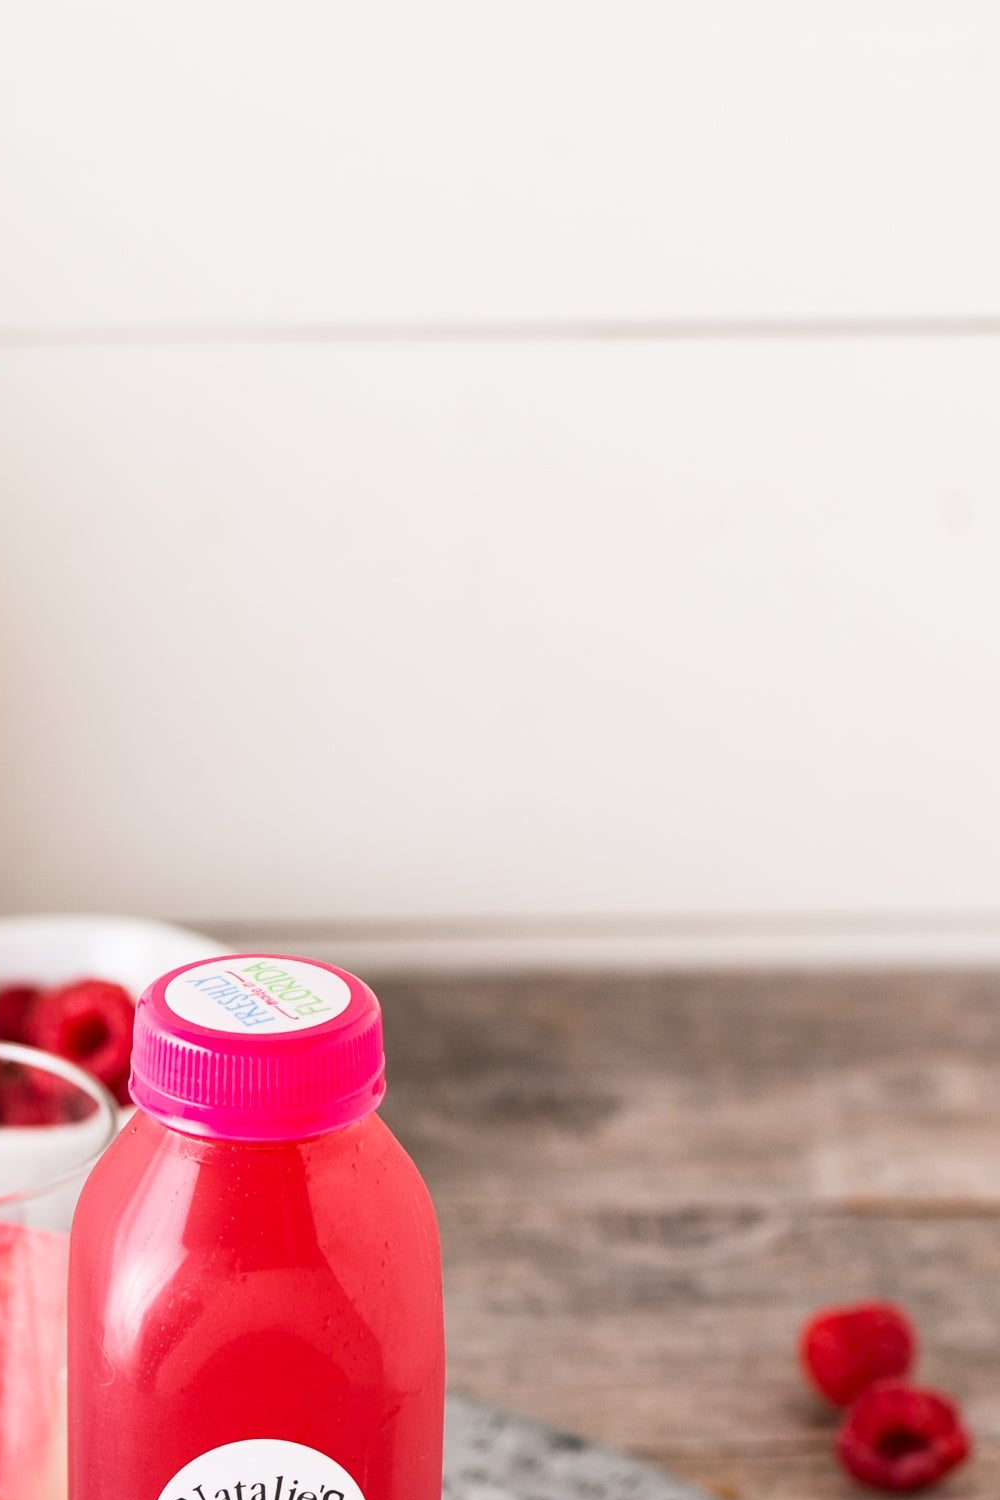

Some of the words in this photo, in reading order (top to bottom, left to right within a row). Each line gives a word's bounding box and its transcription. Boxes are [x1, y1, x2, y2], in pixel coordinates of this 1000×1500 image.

[188, 975, 276, 1028] FRESHLY
[241, 961, 331, 1017] FLORIDA
[251, 987, 279, 1006] made
